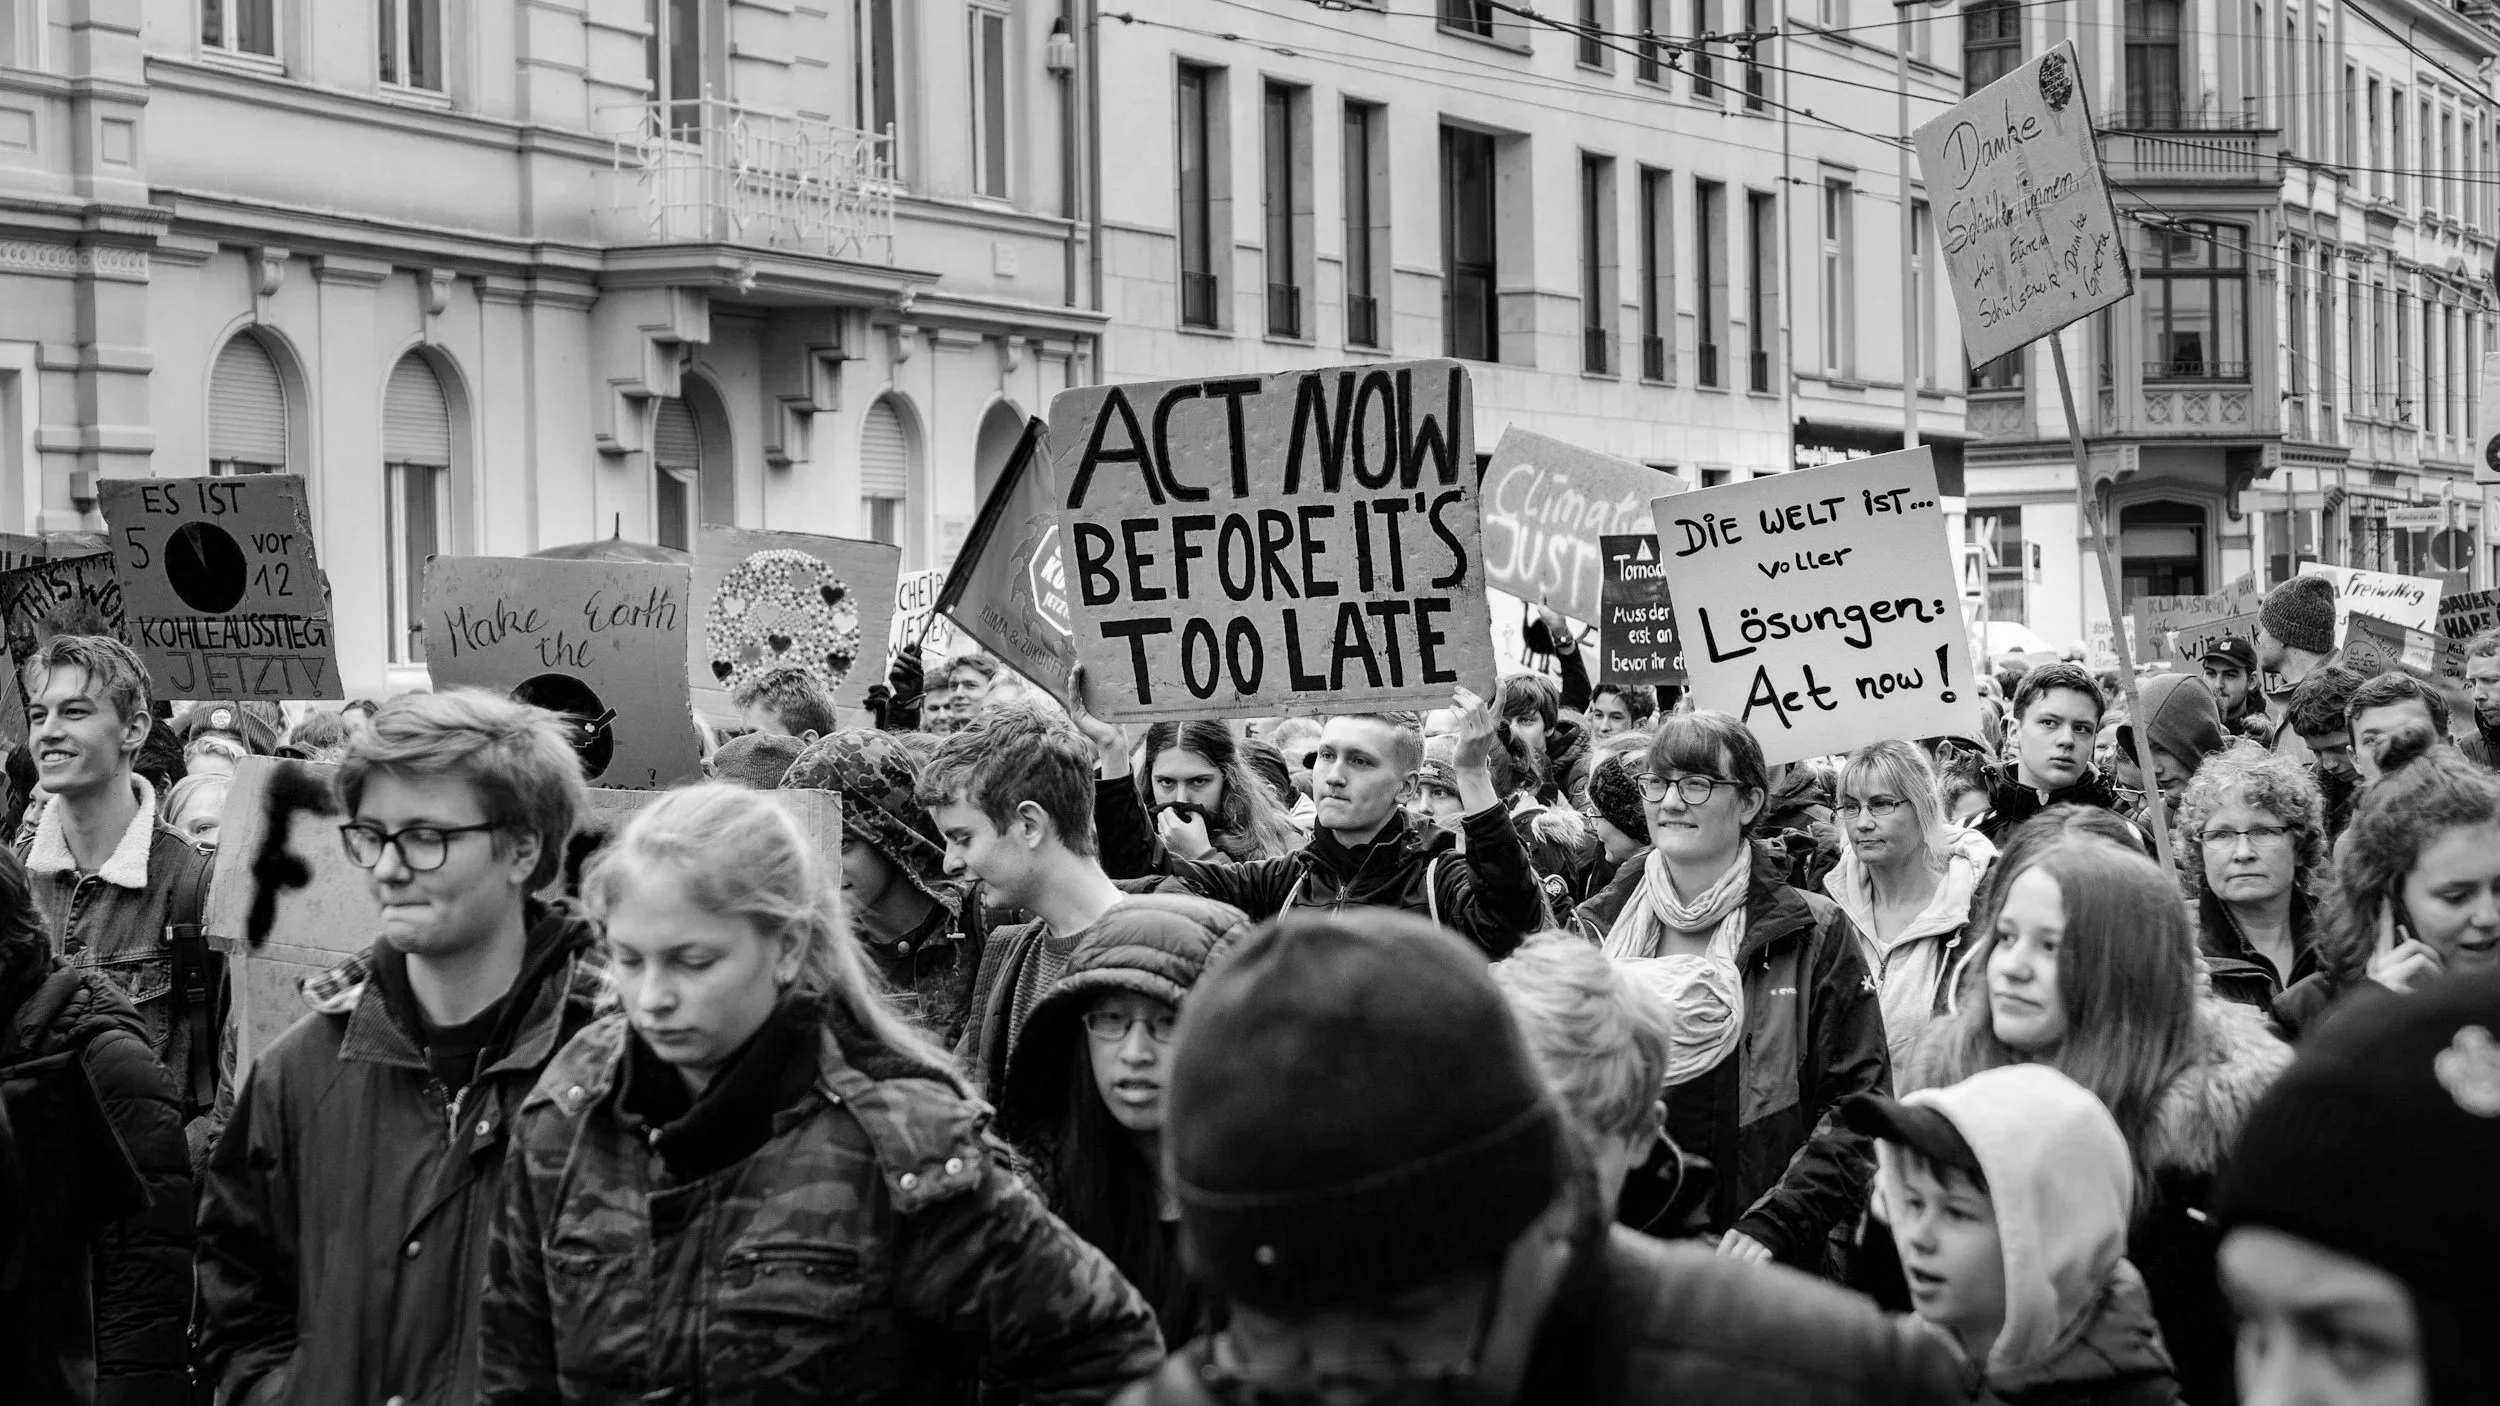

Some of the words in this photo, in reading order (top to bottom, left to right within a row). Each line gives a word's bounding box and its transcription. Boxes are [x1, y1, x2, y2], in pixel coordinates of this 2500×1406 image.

[1943, 99, 2042, 190] Danke
[1066, 378, 1262, 509] ACT
[1282, 367, 1462, 495] NOW
[141, 484, 181, 515] ES
[198, 482, 247, 514] IST
[1760, 497, 1846, 535] WELT
[125, 527, 150, 570] 5
[251, 532, 293, 555] vor
[1073, 505, 1339, 607] BEFORE
[1353, 486, 1468, 593] IT'S
[254, 562, 294, 597] 12
[1758, 547, 1853, 580] voller
[2344, 572, 2425, 607] Freiwillig
[138, 614, 327, 650] KOHLEAUSSTIEG
[443, 598, 550, 658] Make
[583, 586, 677, 633] Earth
[1612, 605, 1646, 625] Muss
[1649, 602, 1670, 622] der
[1697, 597, 1946, 664] Lösungen:
[535, 630, 596, 669] the
[1100, 616, 1264, 705] TOO
[1282, 597, 1457, 692] LATE
[1628, 628, 1651, 644] erst
[1656, 628, 1673, 644] an
[165, 651, 325, 698] JETZT!
[1611, 649, 1648, 673] bevor
[1651, 650, 1667, 671] ihr
[1740, 664, 1838, 729] Act
